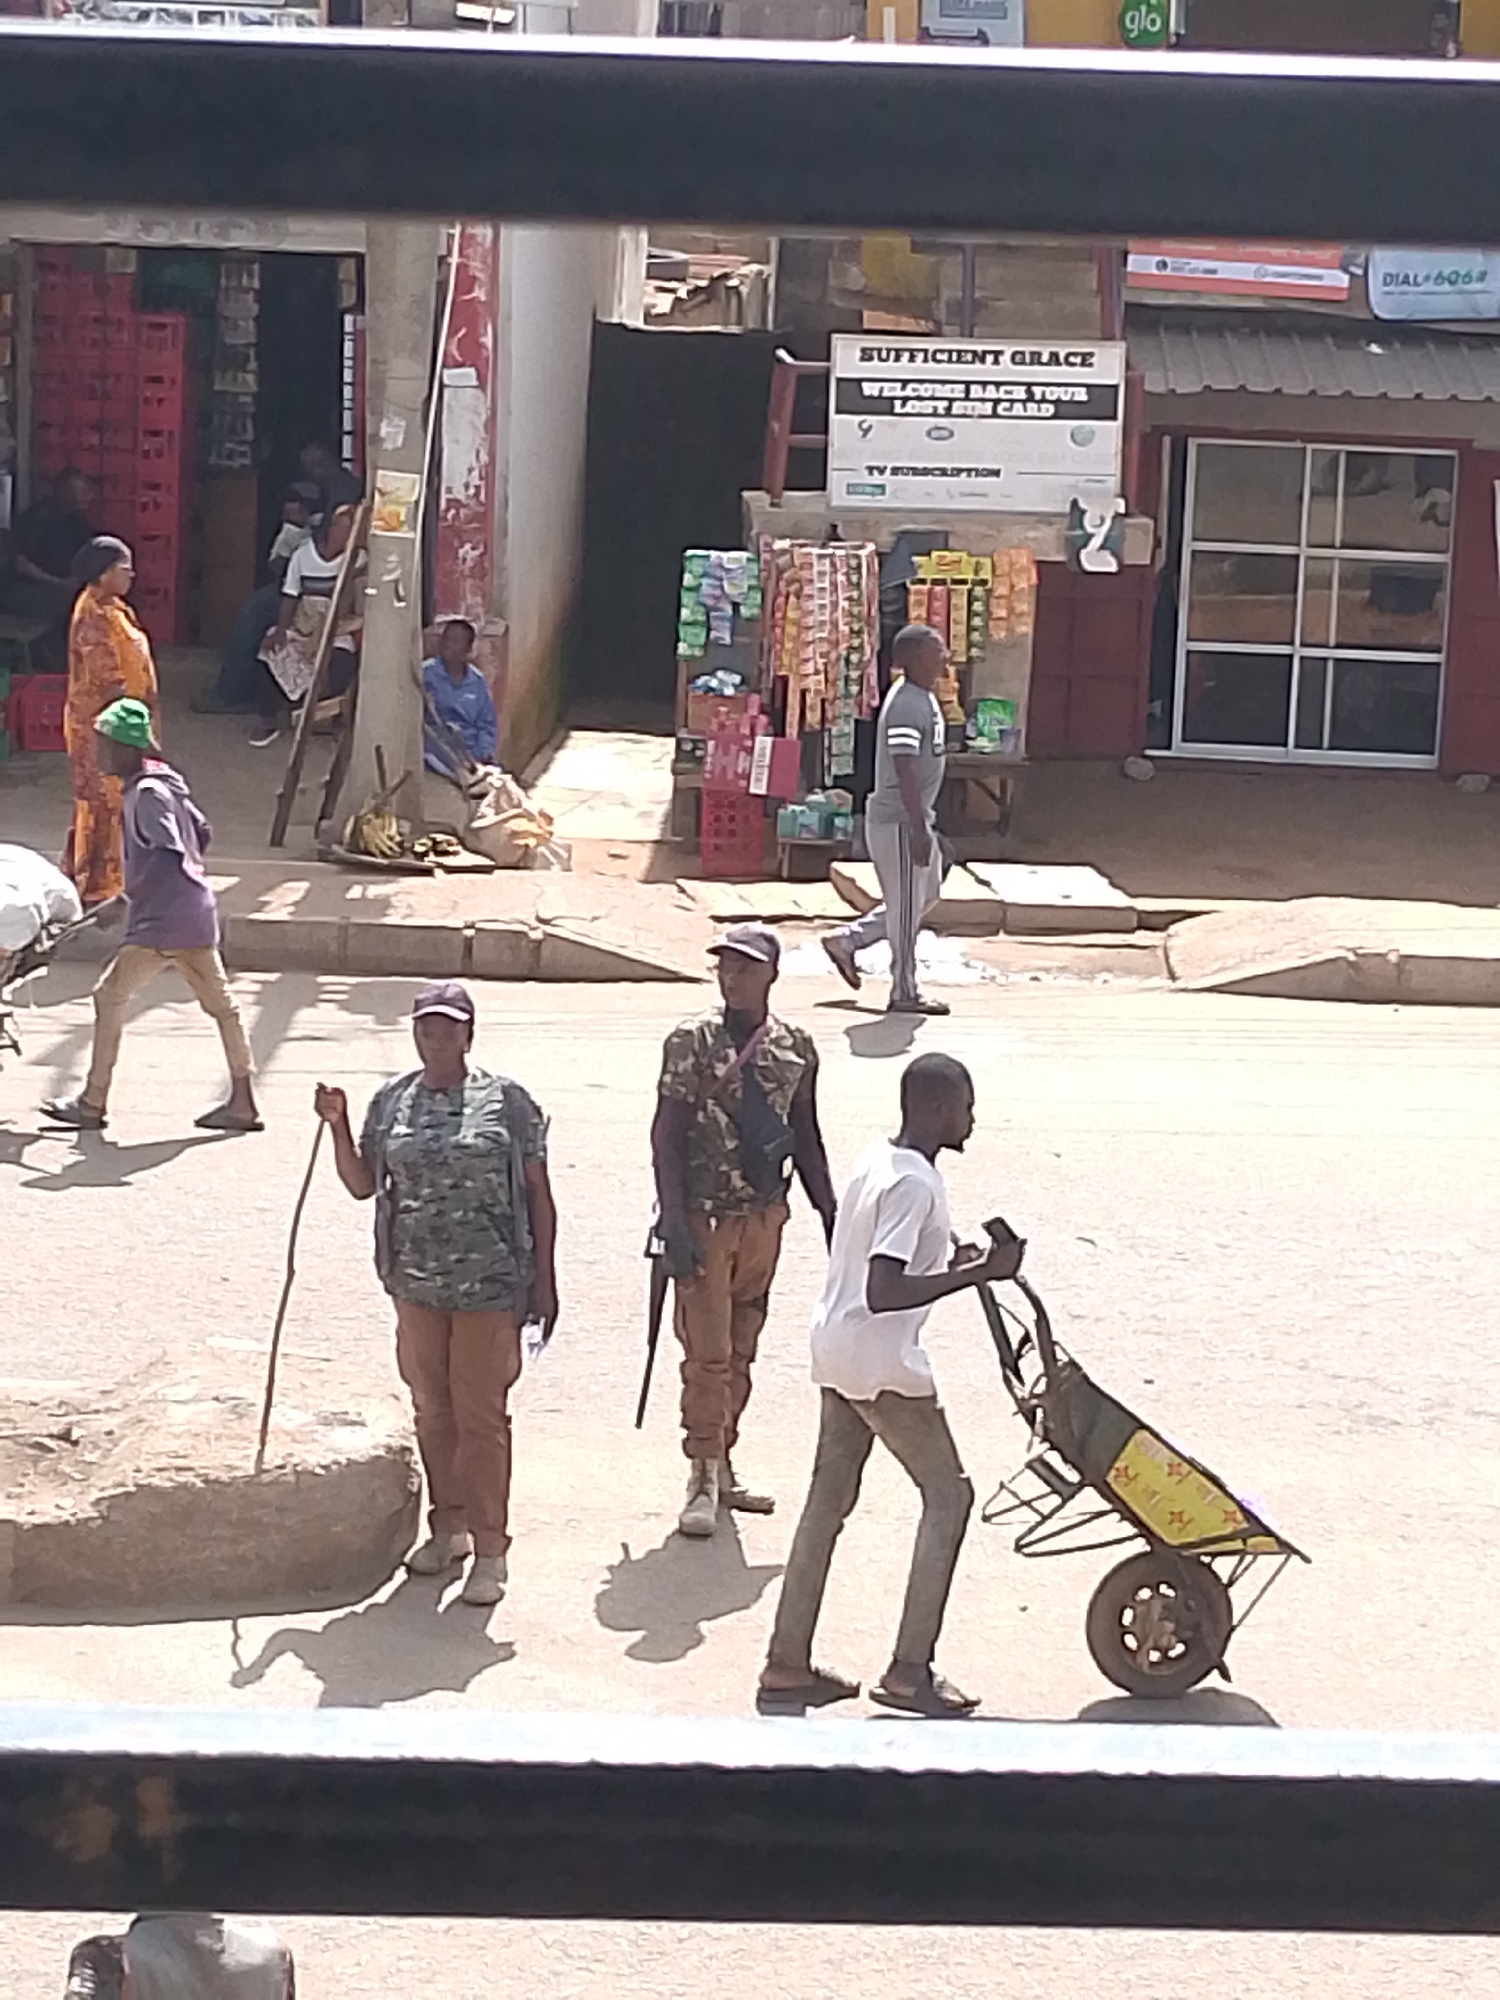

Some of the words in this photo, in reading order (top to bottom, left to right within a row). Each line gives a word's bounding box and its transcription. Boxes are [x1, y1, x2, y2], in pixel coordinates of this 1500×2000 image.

[1125, 9, 1161, 38] glo
[859, 347, 1004, 366] SUFFICIENT
[1010, 350, 1096, 368] GRACE
[861, 382, 965, 398] WELCOME
[969, 384, 1027, 399] BACK
[1031, 386, 1088, 401] YOUR
[893, 399, 949, 414] LOST
[951, 401, 994, 416] SIM
[997, 402, 1055, 417] CARD
[864, 465, 887, 477] TV
[889, 465, 1001, 479] SUBSCRIPTION
